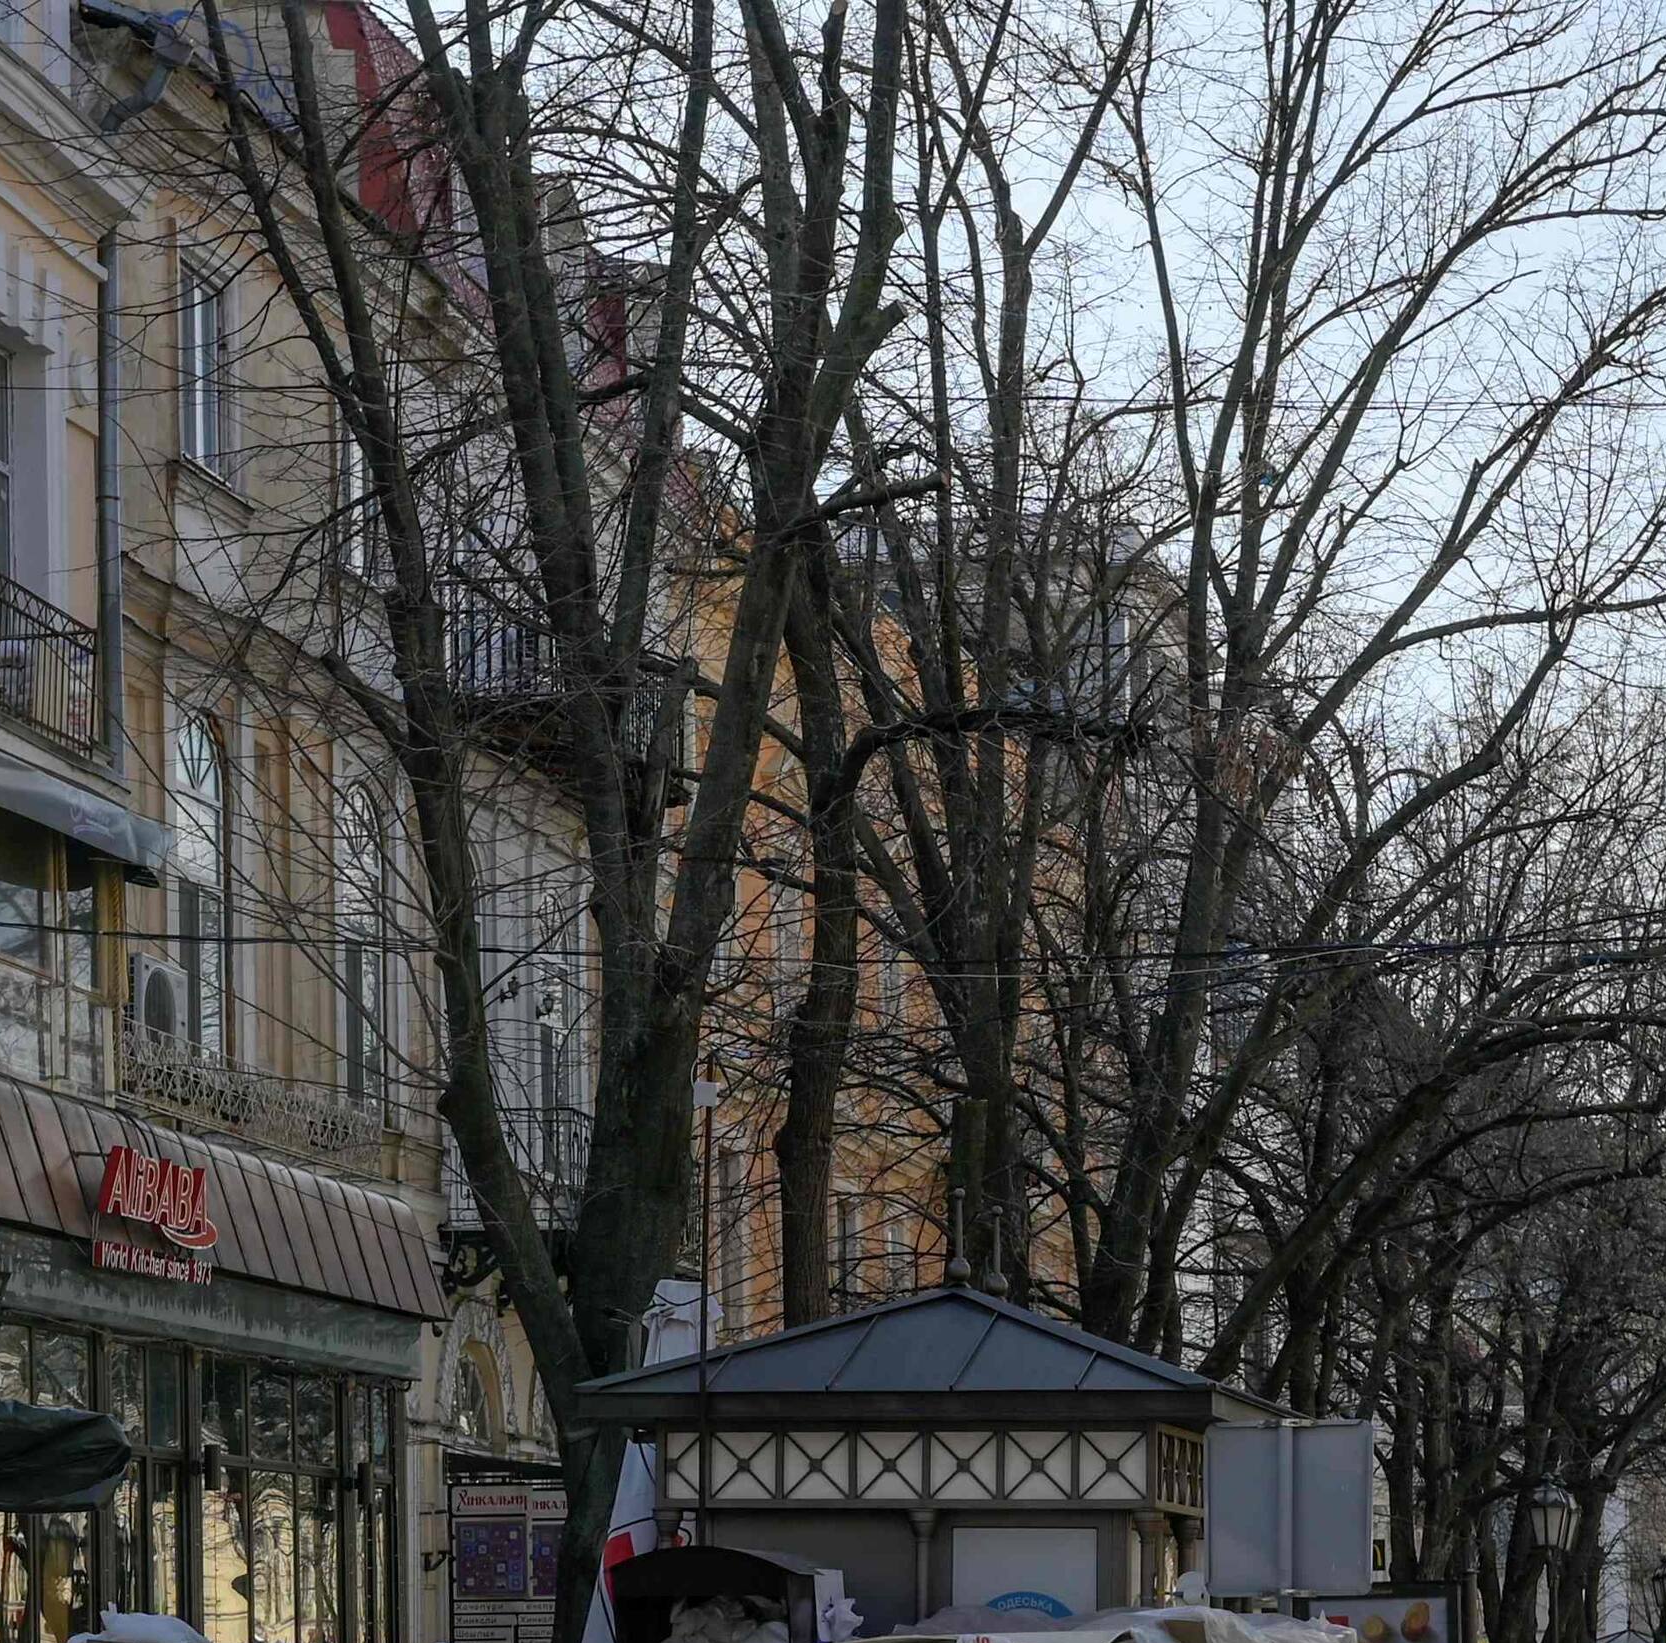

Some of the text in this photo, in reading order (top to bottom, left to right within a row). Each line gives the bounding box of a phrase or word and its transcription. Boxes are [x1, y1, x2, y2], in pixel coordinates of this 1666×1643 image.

[102, 1242, 213, 1286] World Kitchen since 1973
[997, 1596, 1053, 1613] ОДЕСЬКА
